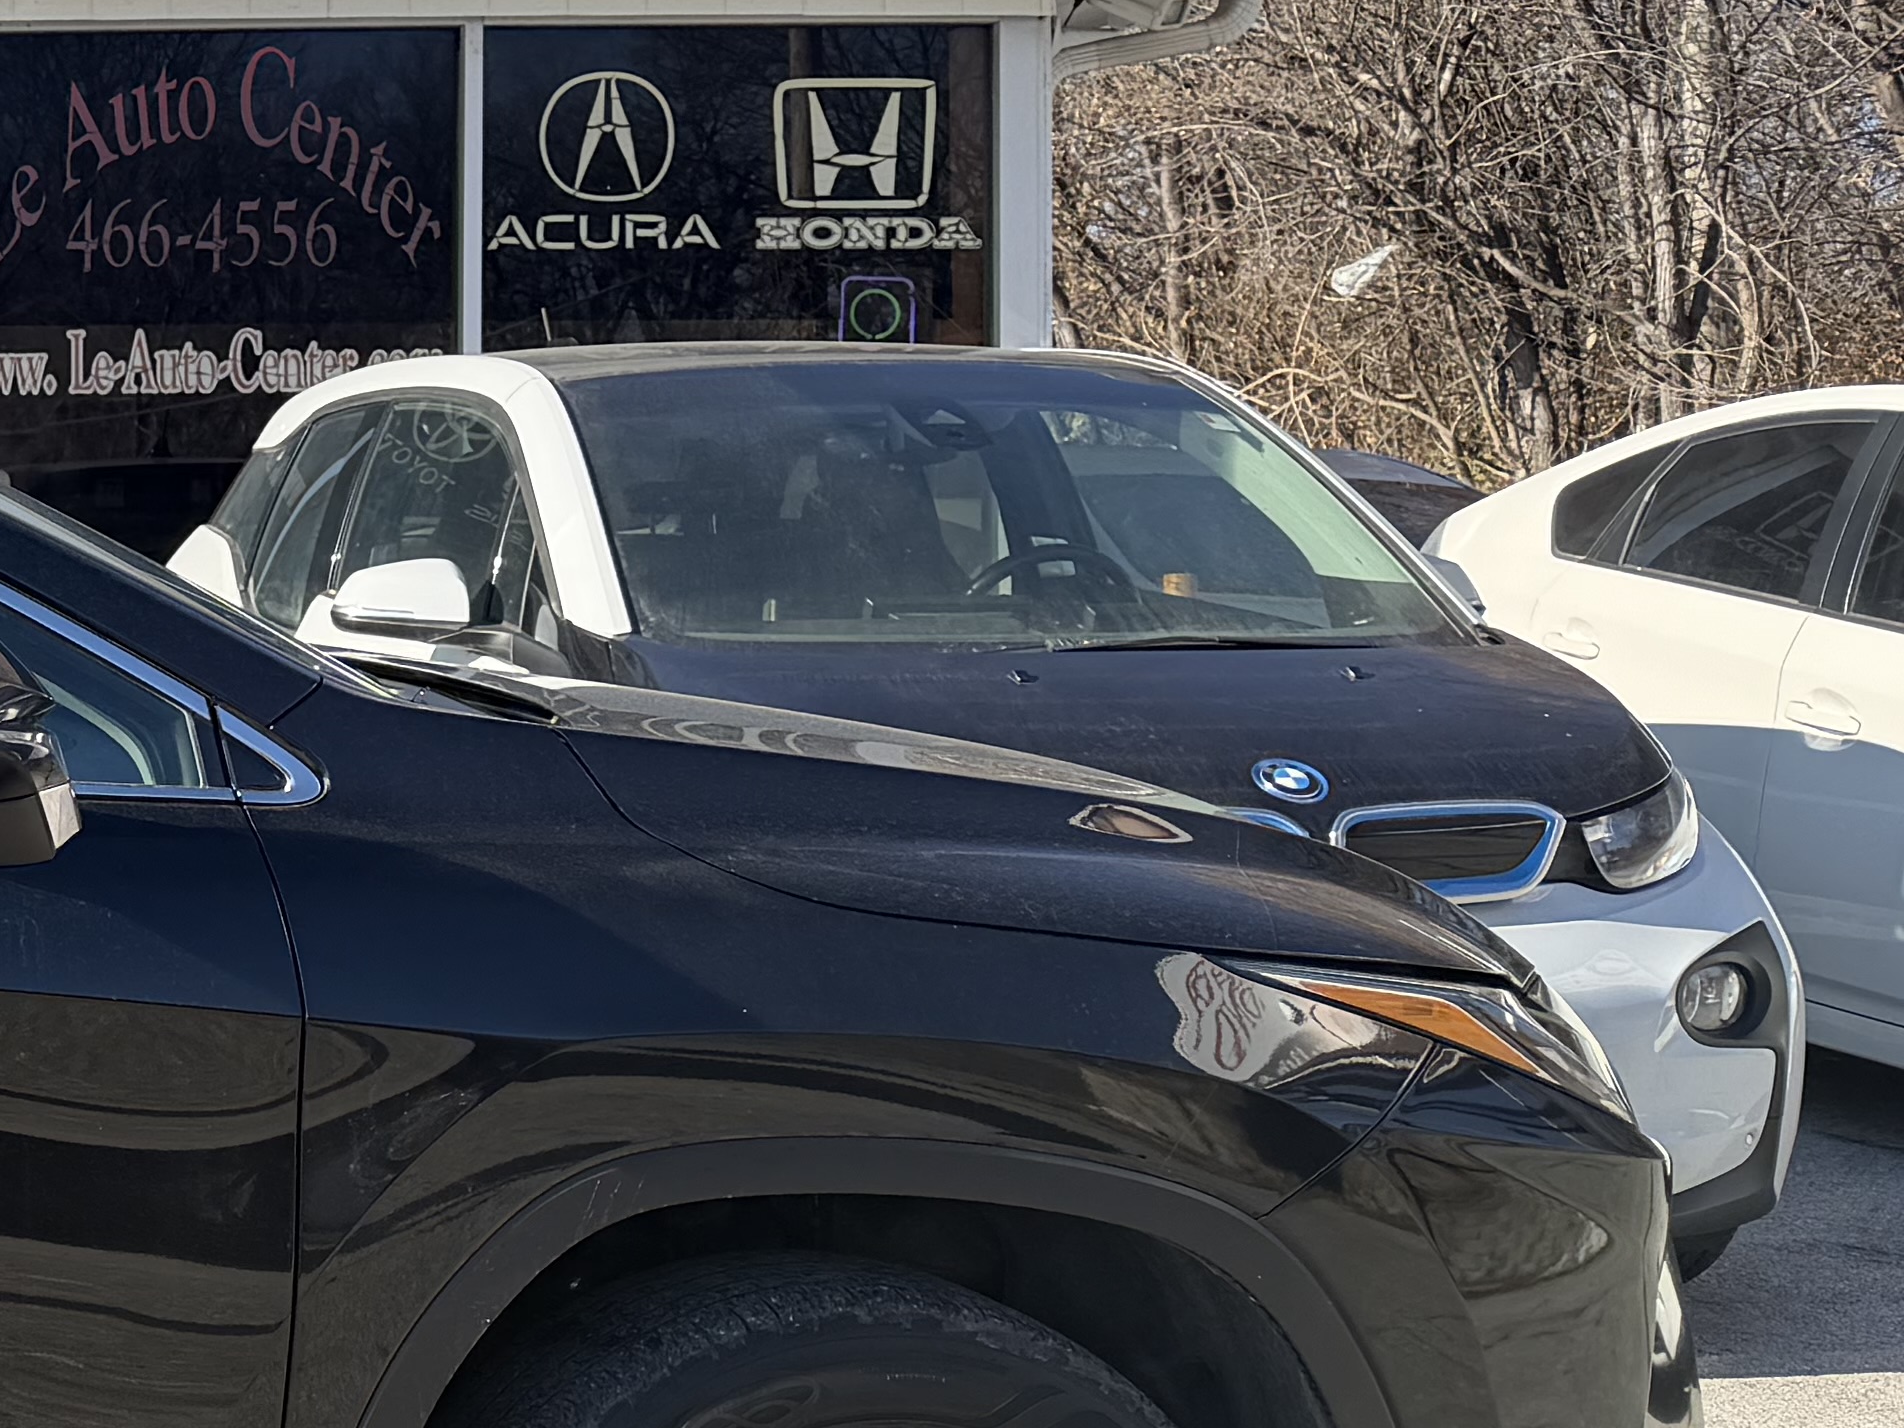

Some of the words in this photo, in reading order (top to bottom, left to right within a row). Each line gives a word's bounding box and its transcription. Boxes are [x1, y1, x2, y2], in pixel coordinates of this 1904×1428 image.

[61, 65, 217, 194] Auto
[239, 45, 443, 269] Center
[65, 197, 339, 274] 466-4556
[486, 213, 722, 251] ACURA
[754, 216, 984, 251] HONDA
[65, 327, 444, 396] Le-Auto-Center
